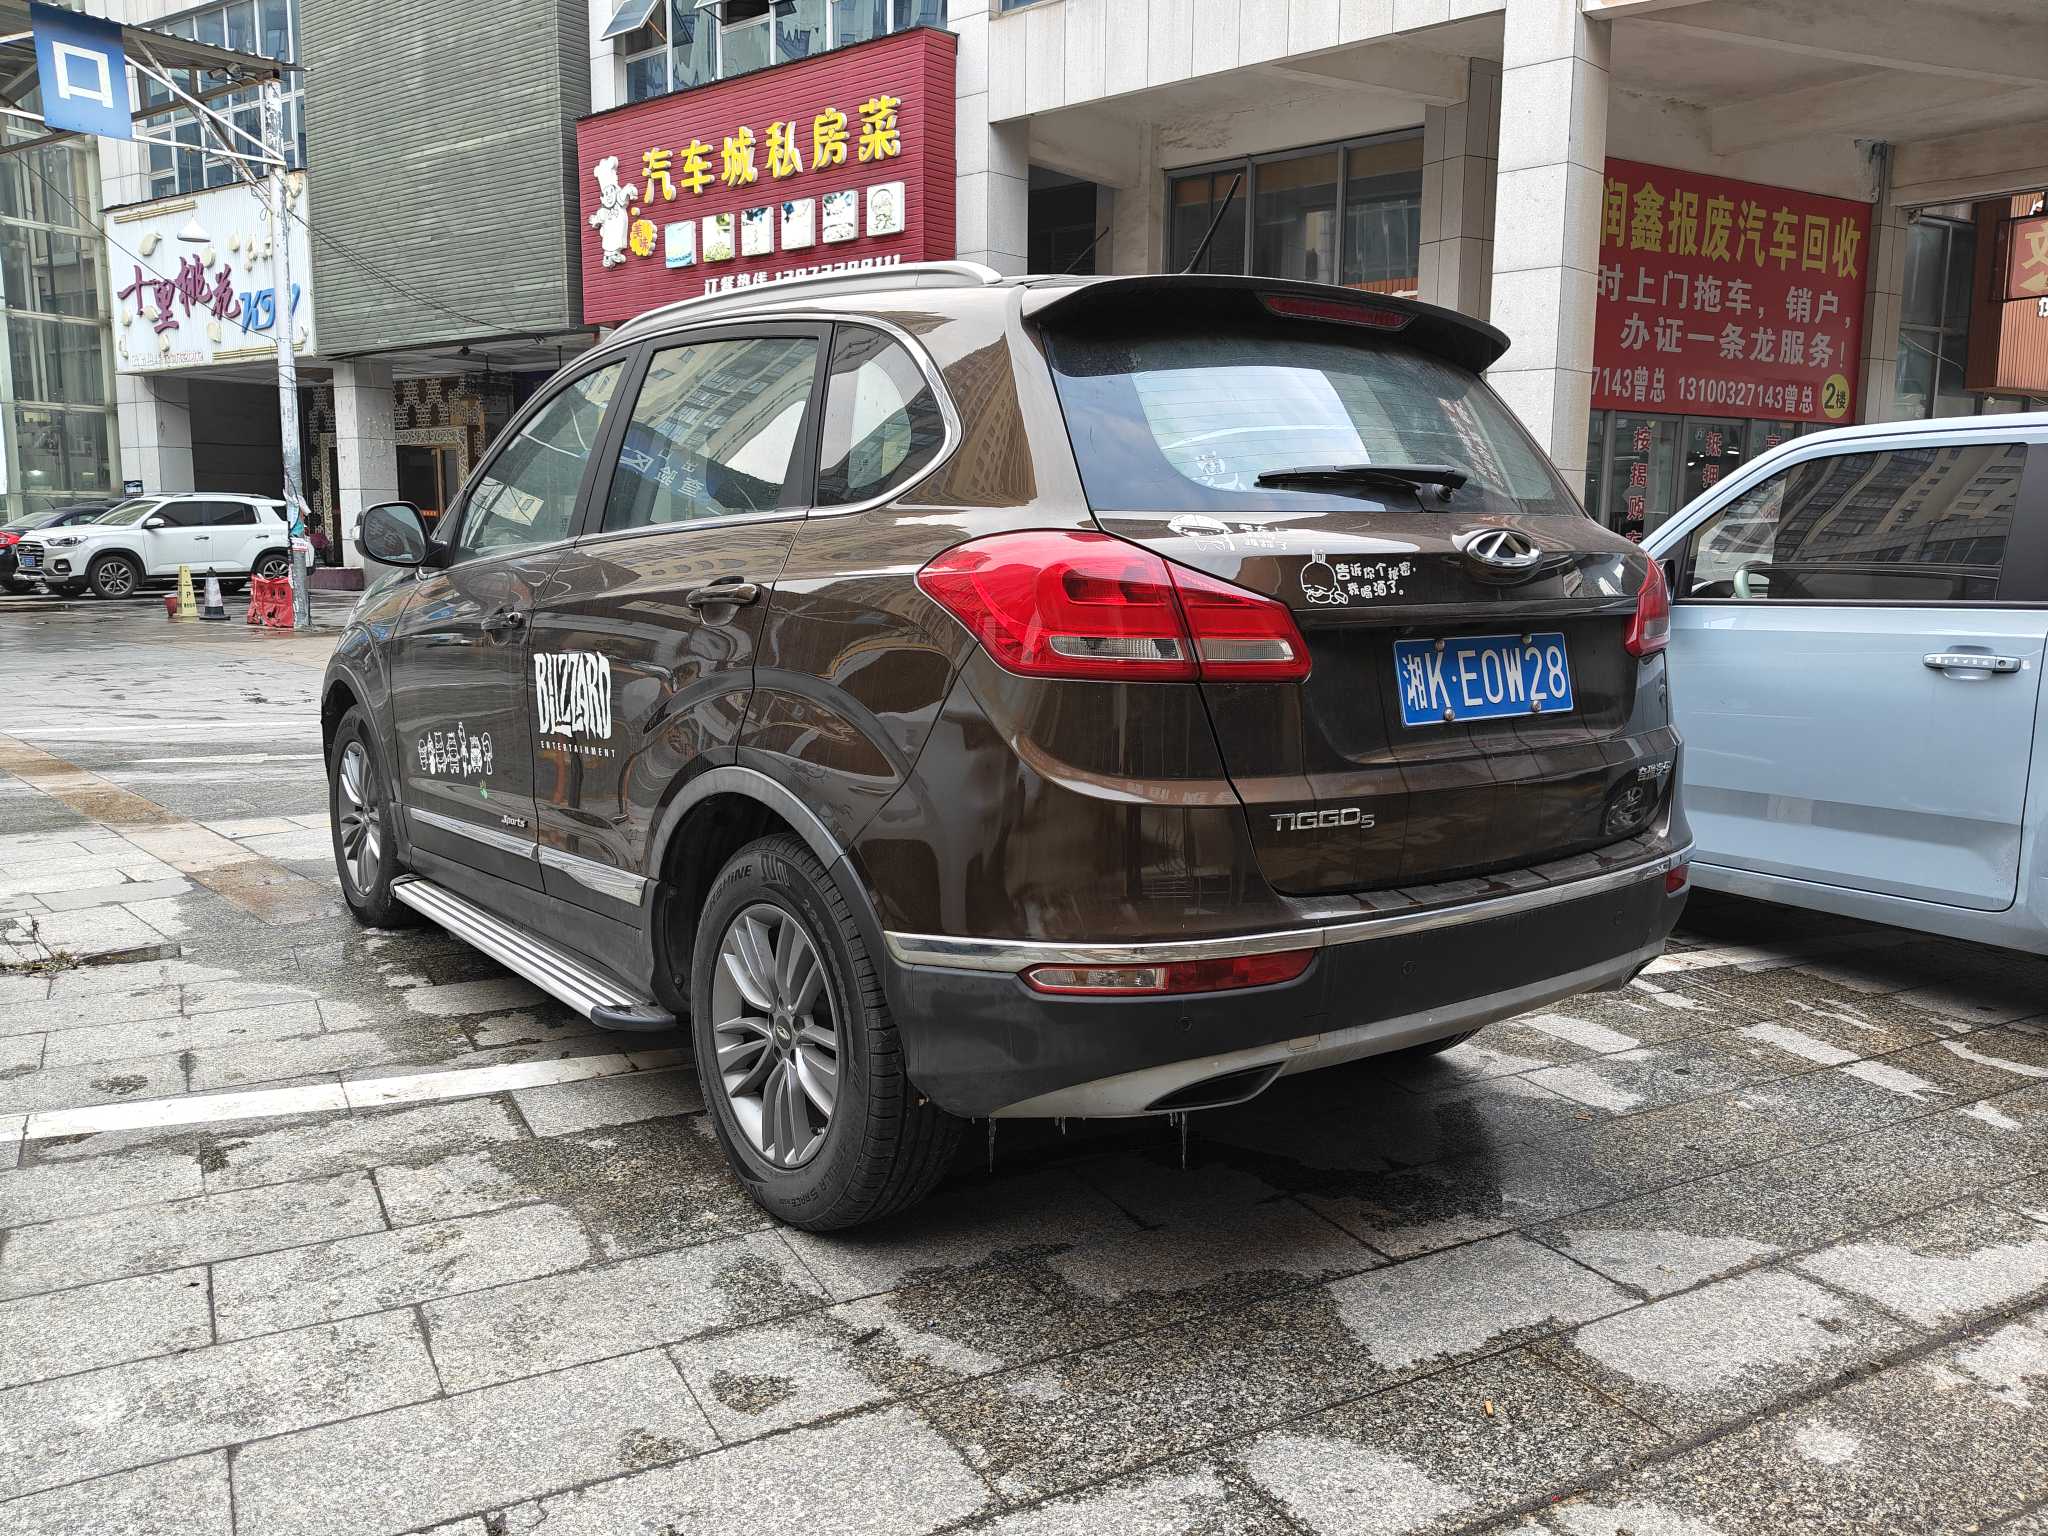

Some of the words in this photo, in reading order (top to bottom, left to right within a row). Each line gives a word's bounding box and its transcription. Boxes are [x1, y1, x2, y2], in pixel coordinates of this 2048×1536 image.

[642, 95, 901, 203] 汽车城私房菜
[1678, 376, 1814, 413] 13100327143曾总
[1824, 383, 1847, 409] 2楼
[533, 651, 612, 740] BLIZZARD
[540, 740, 616, 758] ENTERTAINMENT
